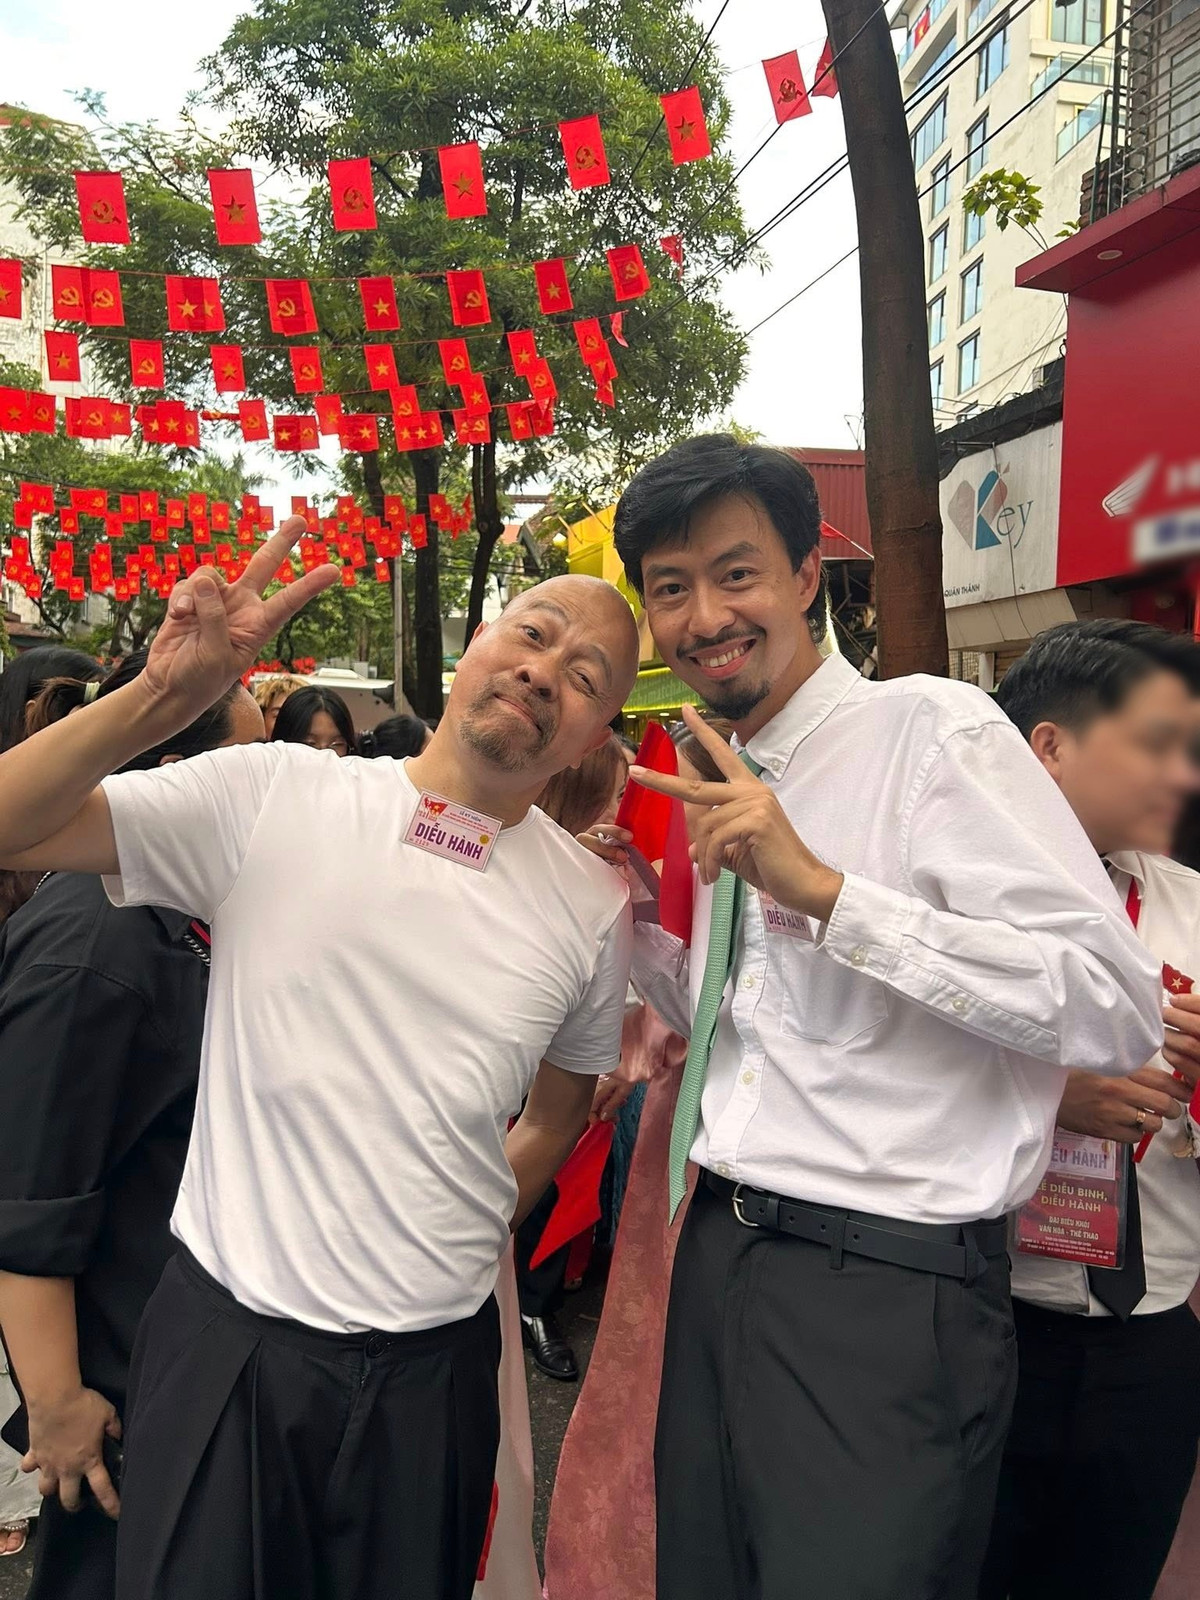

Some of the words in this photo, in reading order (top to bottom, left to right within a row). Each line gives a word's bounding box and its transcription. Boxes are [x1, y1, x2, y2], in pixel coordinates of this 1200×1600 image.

[447, 835, 483, 860] HÀNH
[1072, 1148, 1107, 1169] HÀNH
[1078, 1188, 1107, 1202] BINH,
[1069, 1199, 1101, 1212] HÀNH
